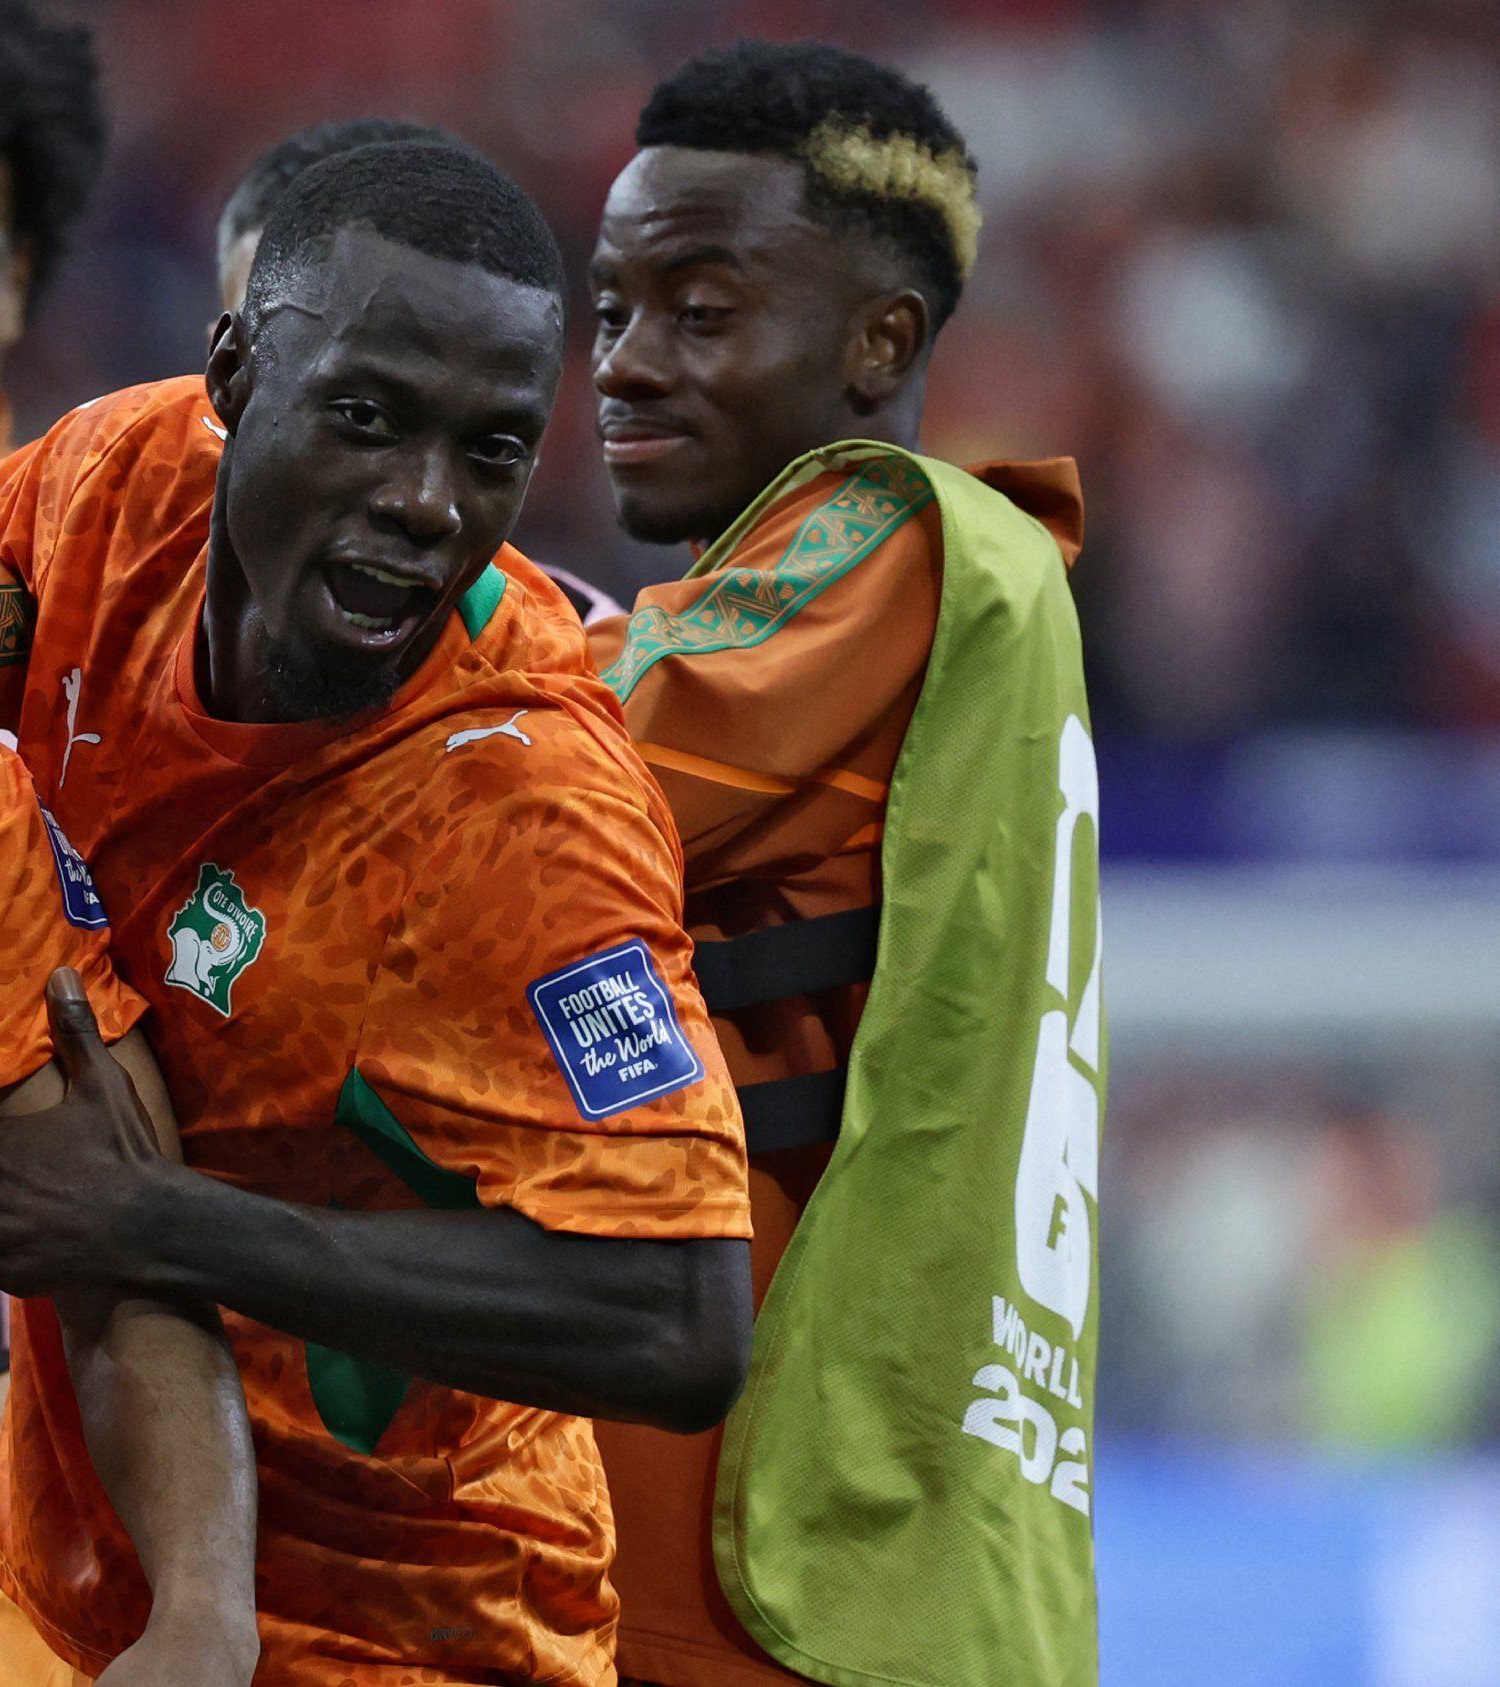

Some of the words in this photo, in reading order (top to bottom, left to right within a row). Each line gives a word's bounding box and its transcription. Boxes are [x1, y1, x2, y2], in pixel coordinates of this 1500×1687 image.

[558, 971, 640, 1019] FOOTBALL
[569, 992, 656, 1048] UNITES
[580, 1047, 616, 1077] the
[614, 1018, 672, 1062] World
[617, 1058, 656, 1082] FIFA
[962, 1363, 1090, 1518] 202
